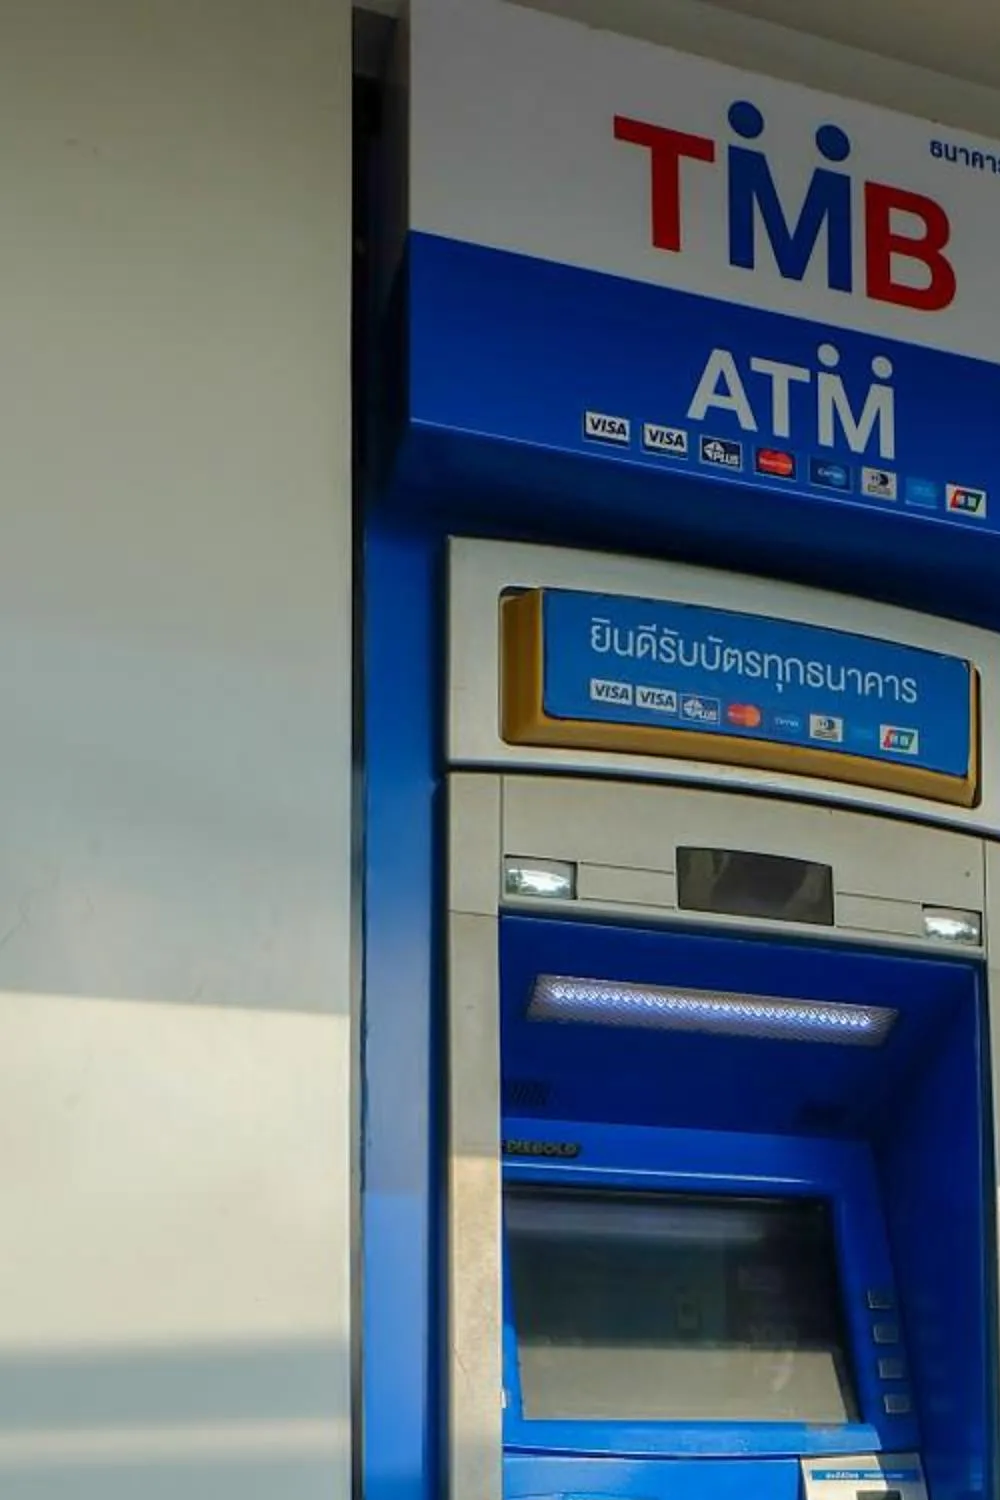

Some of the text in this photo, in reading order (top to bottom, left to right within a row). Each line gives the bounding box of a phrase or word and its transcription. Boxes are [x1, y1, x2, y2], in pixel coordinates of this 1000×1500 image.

[613, 100, 957, 312] TMB
[687, 343, 895, 460] ATM
[590, 416, 627, 436] VISA
[648, 429, 685, 448] VISA
[590, 617, 918, 704] ยินดีรับบัตรทุกธนาคาร
[595, 684, 630, 700] VISA
[640, 691, 674, 708] VISA
